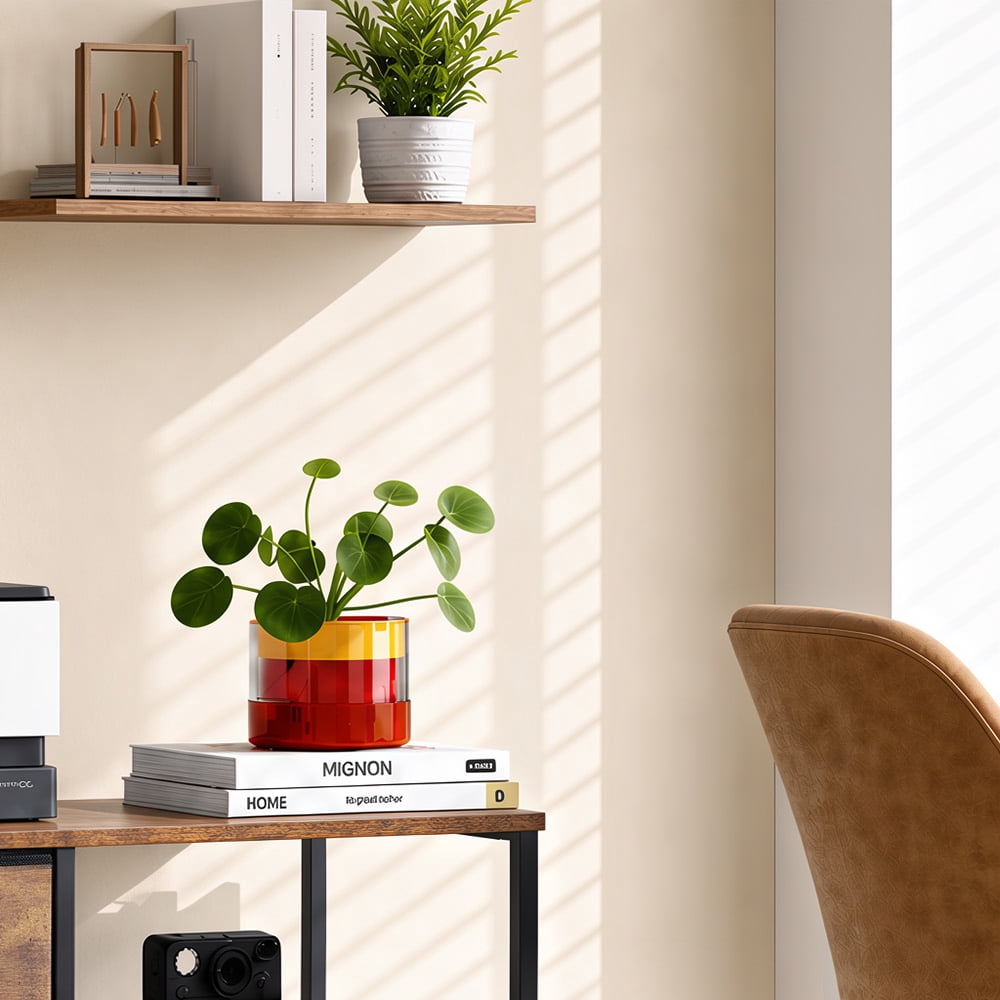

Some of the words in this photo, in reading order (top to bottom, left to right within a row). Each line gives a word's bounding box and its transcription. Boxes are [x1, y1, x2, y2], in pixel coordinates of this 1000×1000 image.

[322, 760, 392, 777] MIGNON
[247, 796, 287, 810] HOME
[495, 789, 505, 803] D
